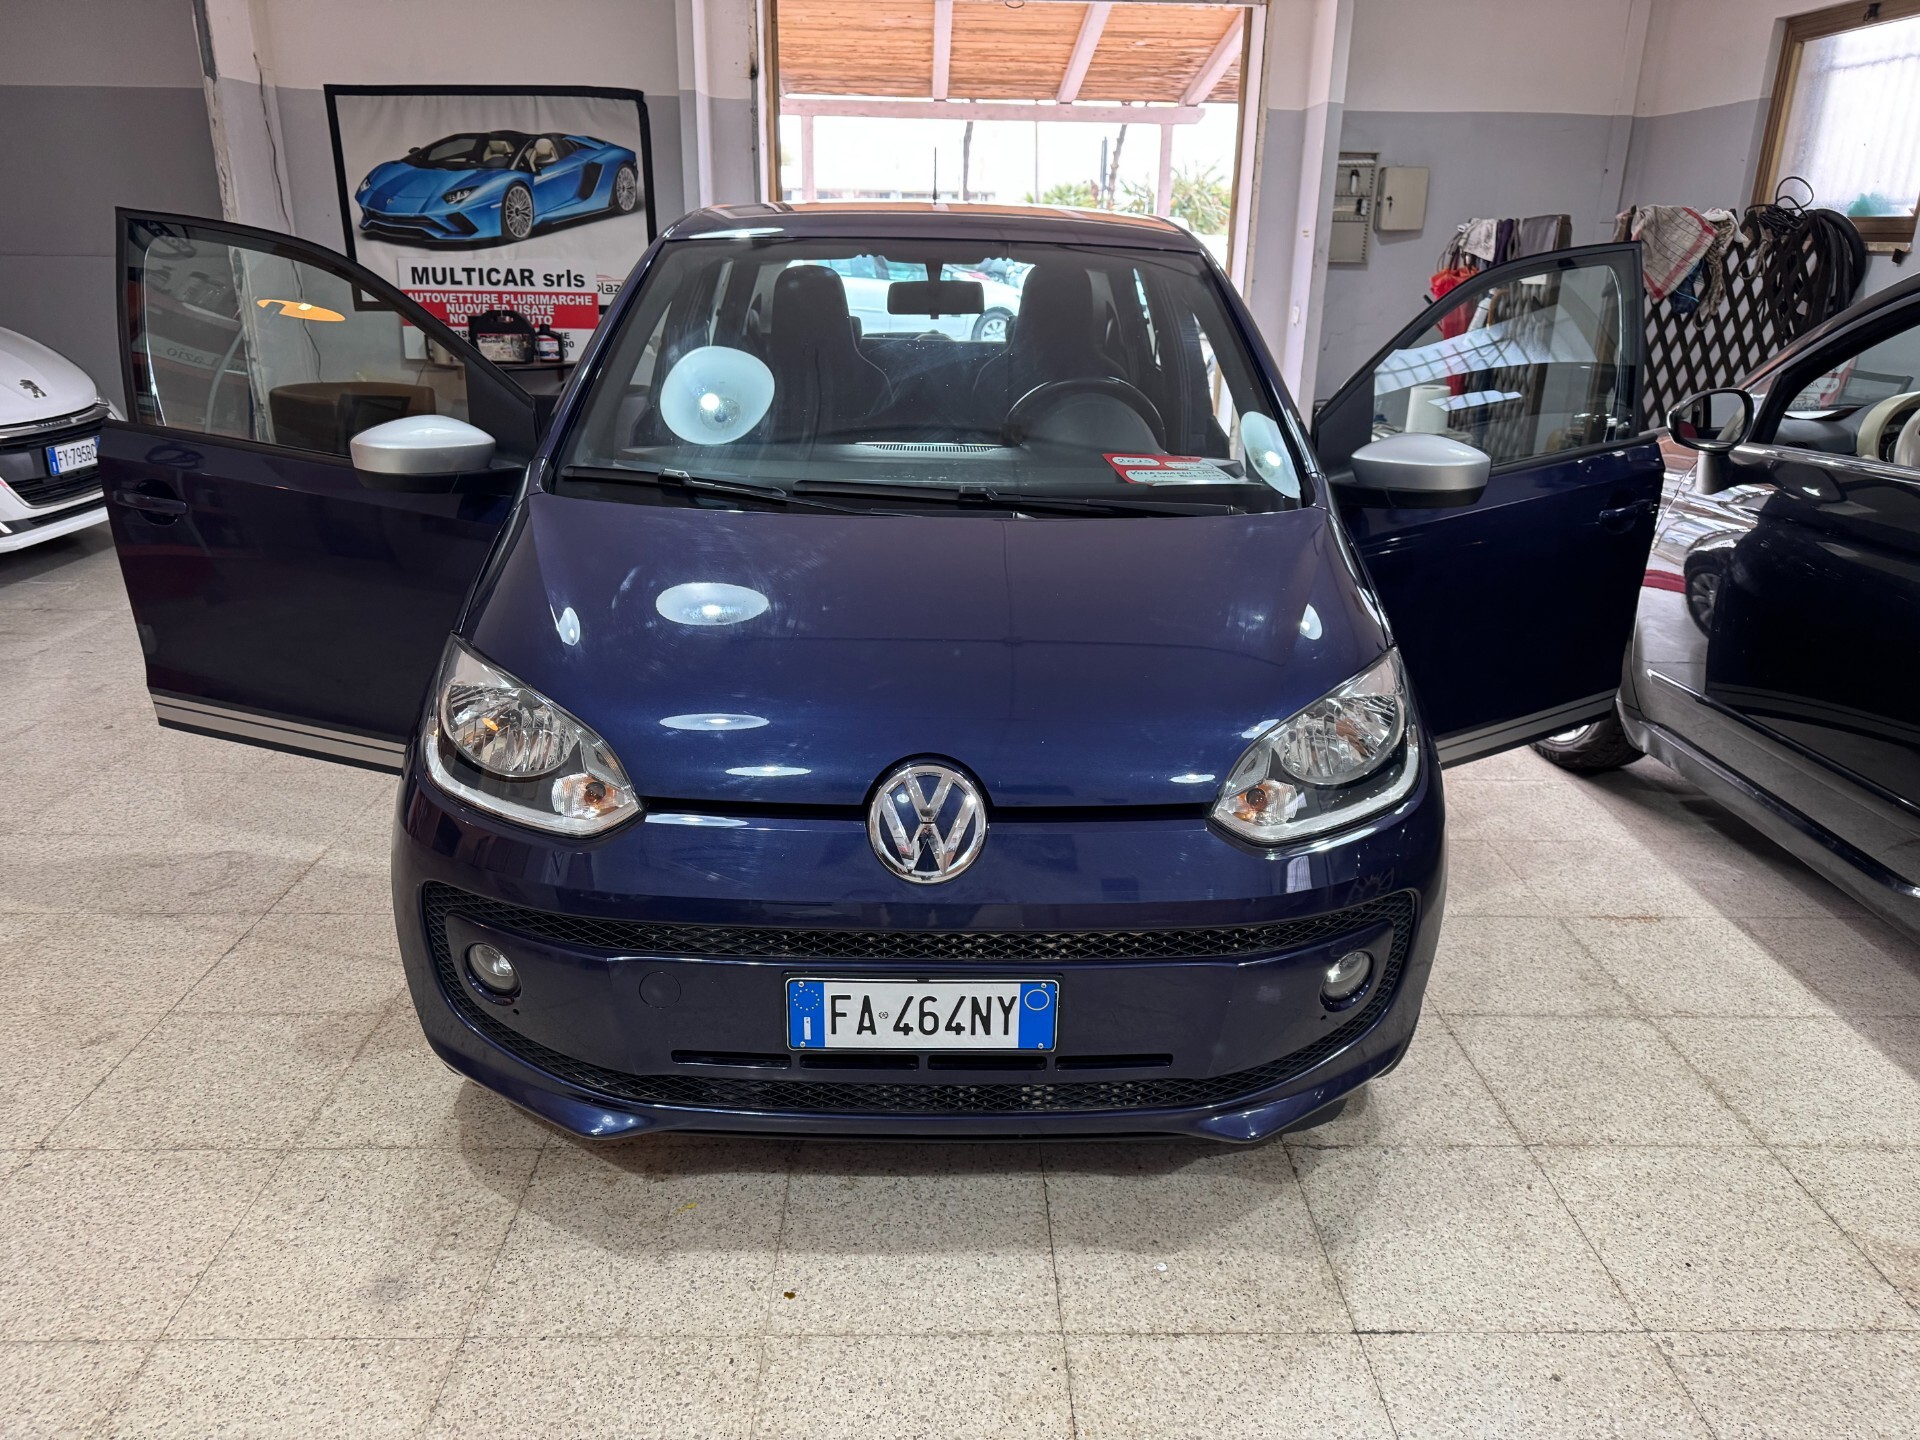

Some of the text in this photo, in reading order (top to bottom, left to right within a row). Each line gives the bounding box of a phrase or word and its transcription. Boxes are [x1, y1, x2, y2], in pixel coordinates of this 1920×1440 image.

[411, 266, 585, 288] MULTICAR srls
[407, 292, 593, 306] AUTOVETTURE PLURIMARCHE
[446, 303, 490, 314] NUOVE
[513, 304, 555, 315] USATE
[526, 315, 553, 326] UTO
[830, 994, 1018, 1036] FA 464NY
